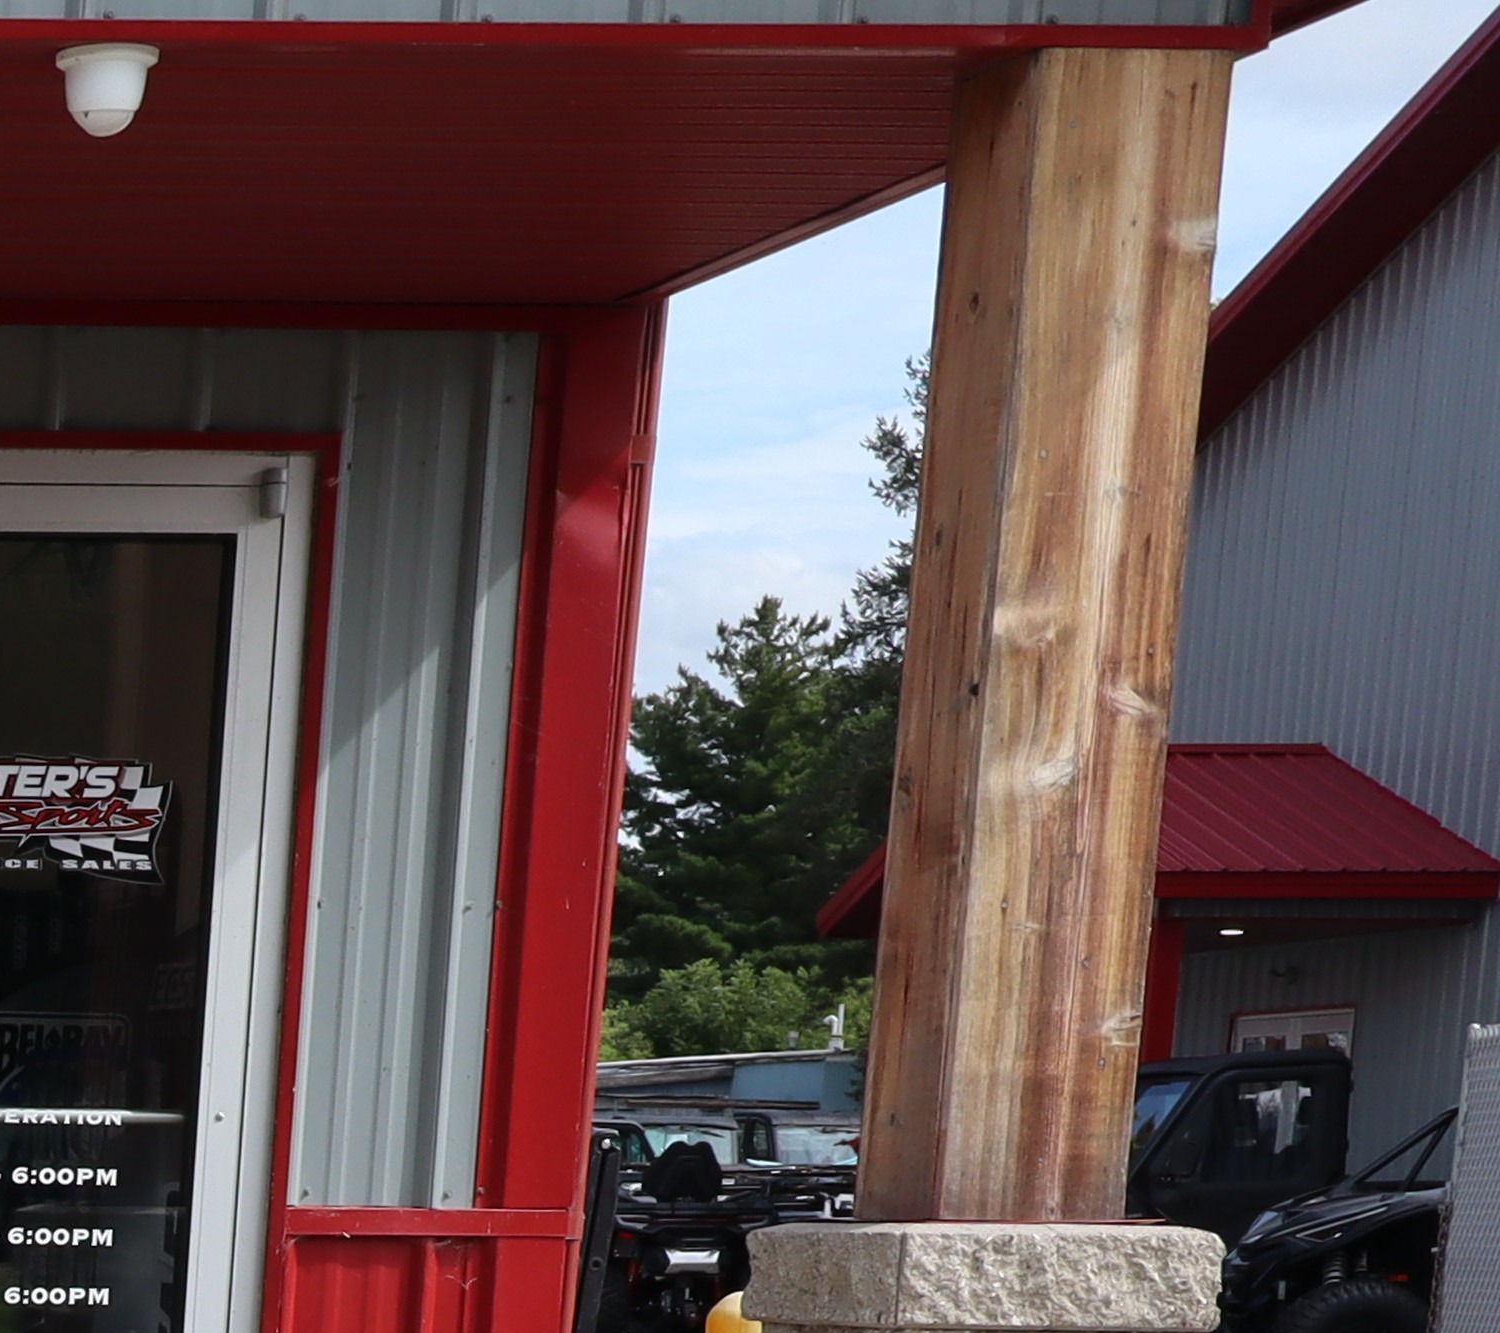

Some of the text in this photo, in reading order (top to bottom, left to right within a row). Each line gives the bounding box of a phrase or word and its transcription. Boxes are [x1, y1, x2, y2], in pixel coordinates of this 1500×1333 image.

[60, 859, 153, 871] SALES
[11, 1166, 118, 1186] 6:00PM
[7, 1227, 113, 1247] 6:00PM
[4, 1286, 110, 1306] 6:00PM
